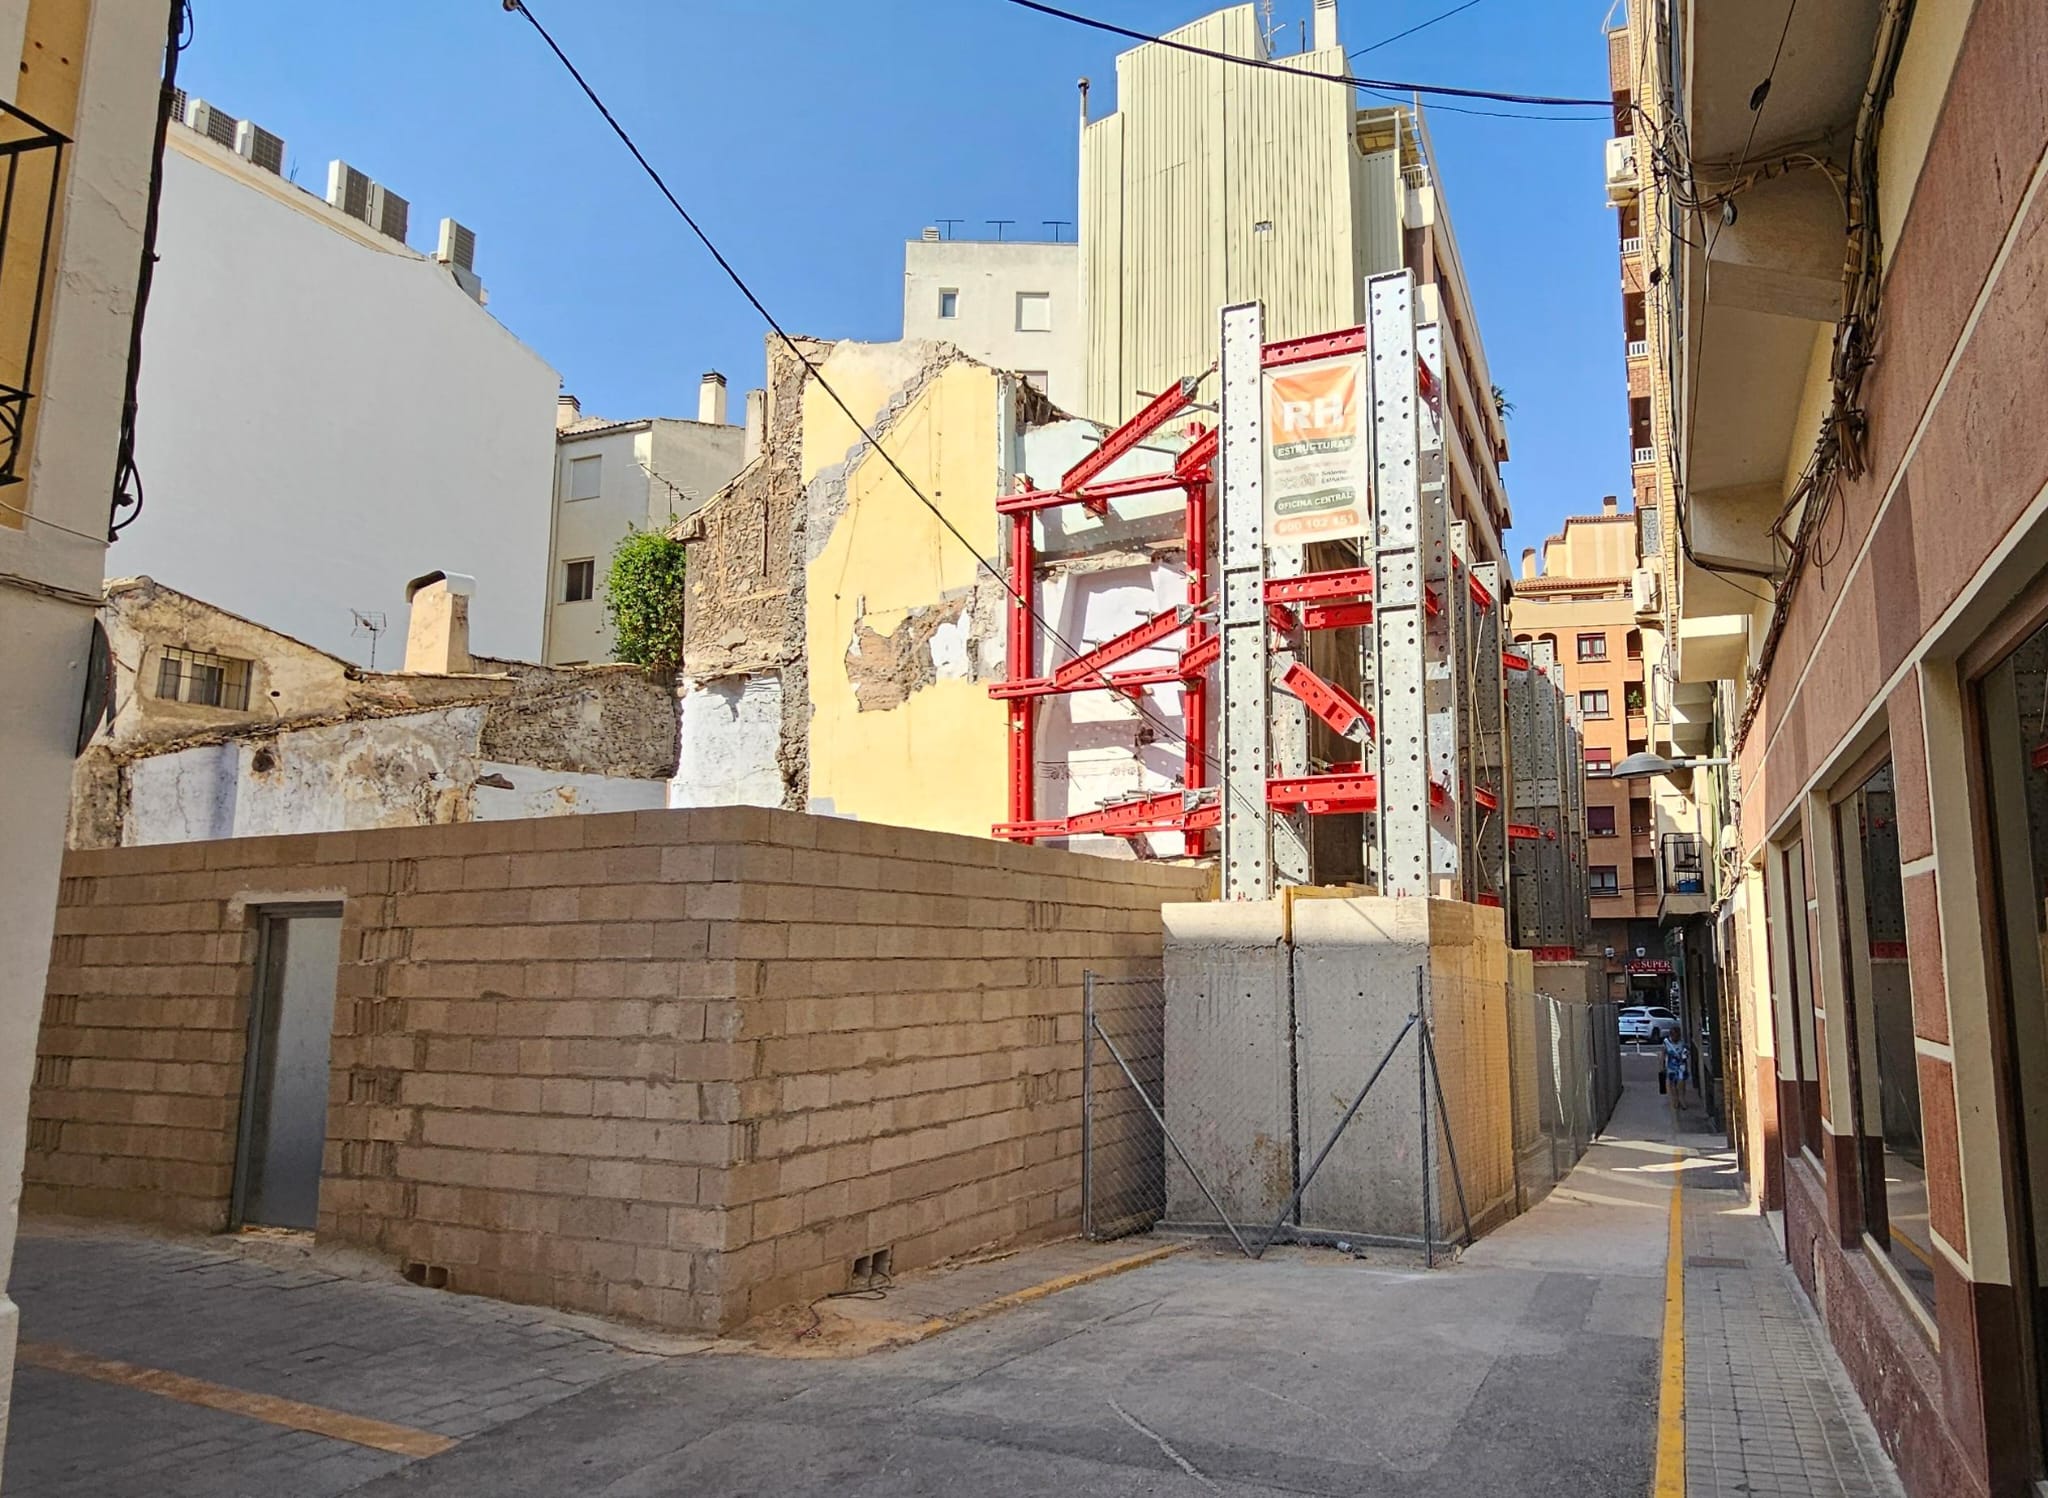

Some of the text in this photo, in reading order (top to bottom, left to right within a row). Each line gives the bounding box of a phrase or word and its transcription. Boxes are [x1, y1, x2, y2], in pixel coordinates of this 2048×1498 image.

[1278, 439, 1352, 457] ESTRUCTURAS
[1278, 491, 1353, 511] OFICINA CENTRAL
[1640, 960, 1670, 968] SUPER
